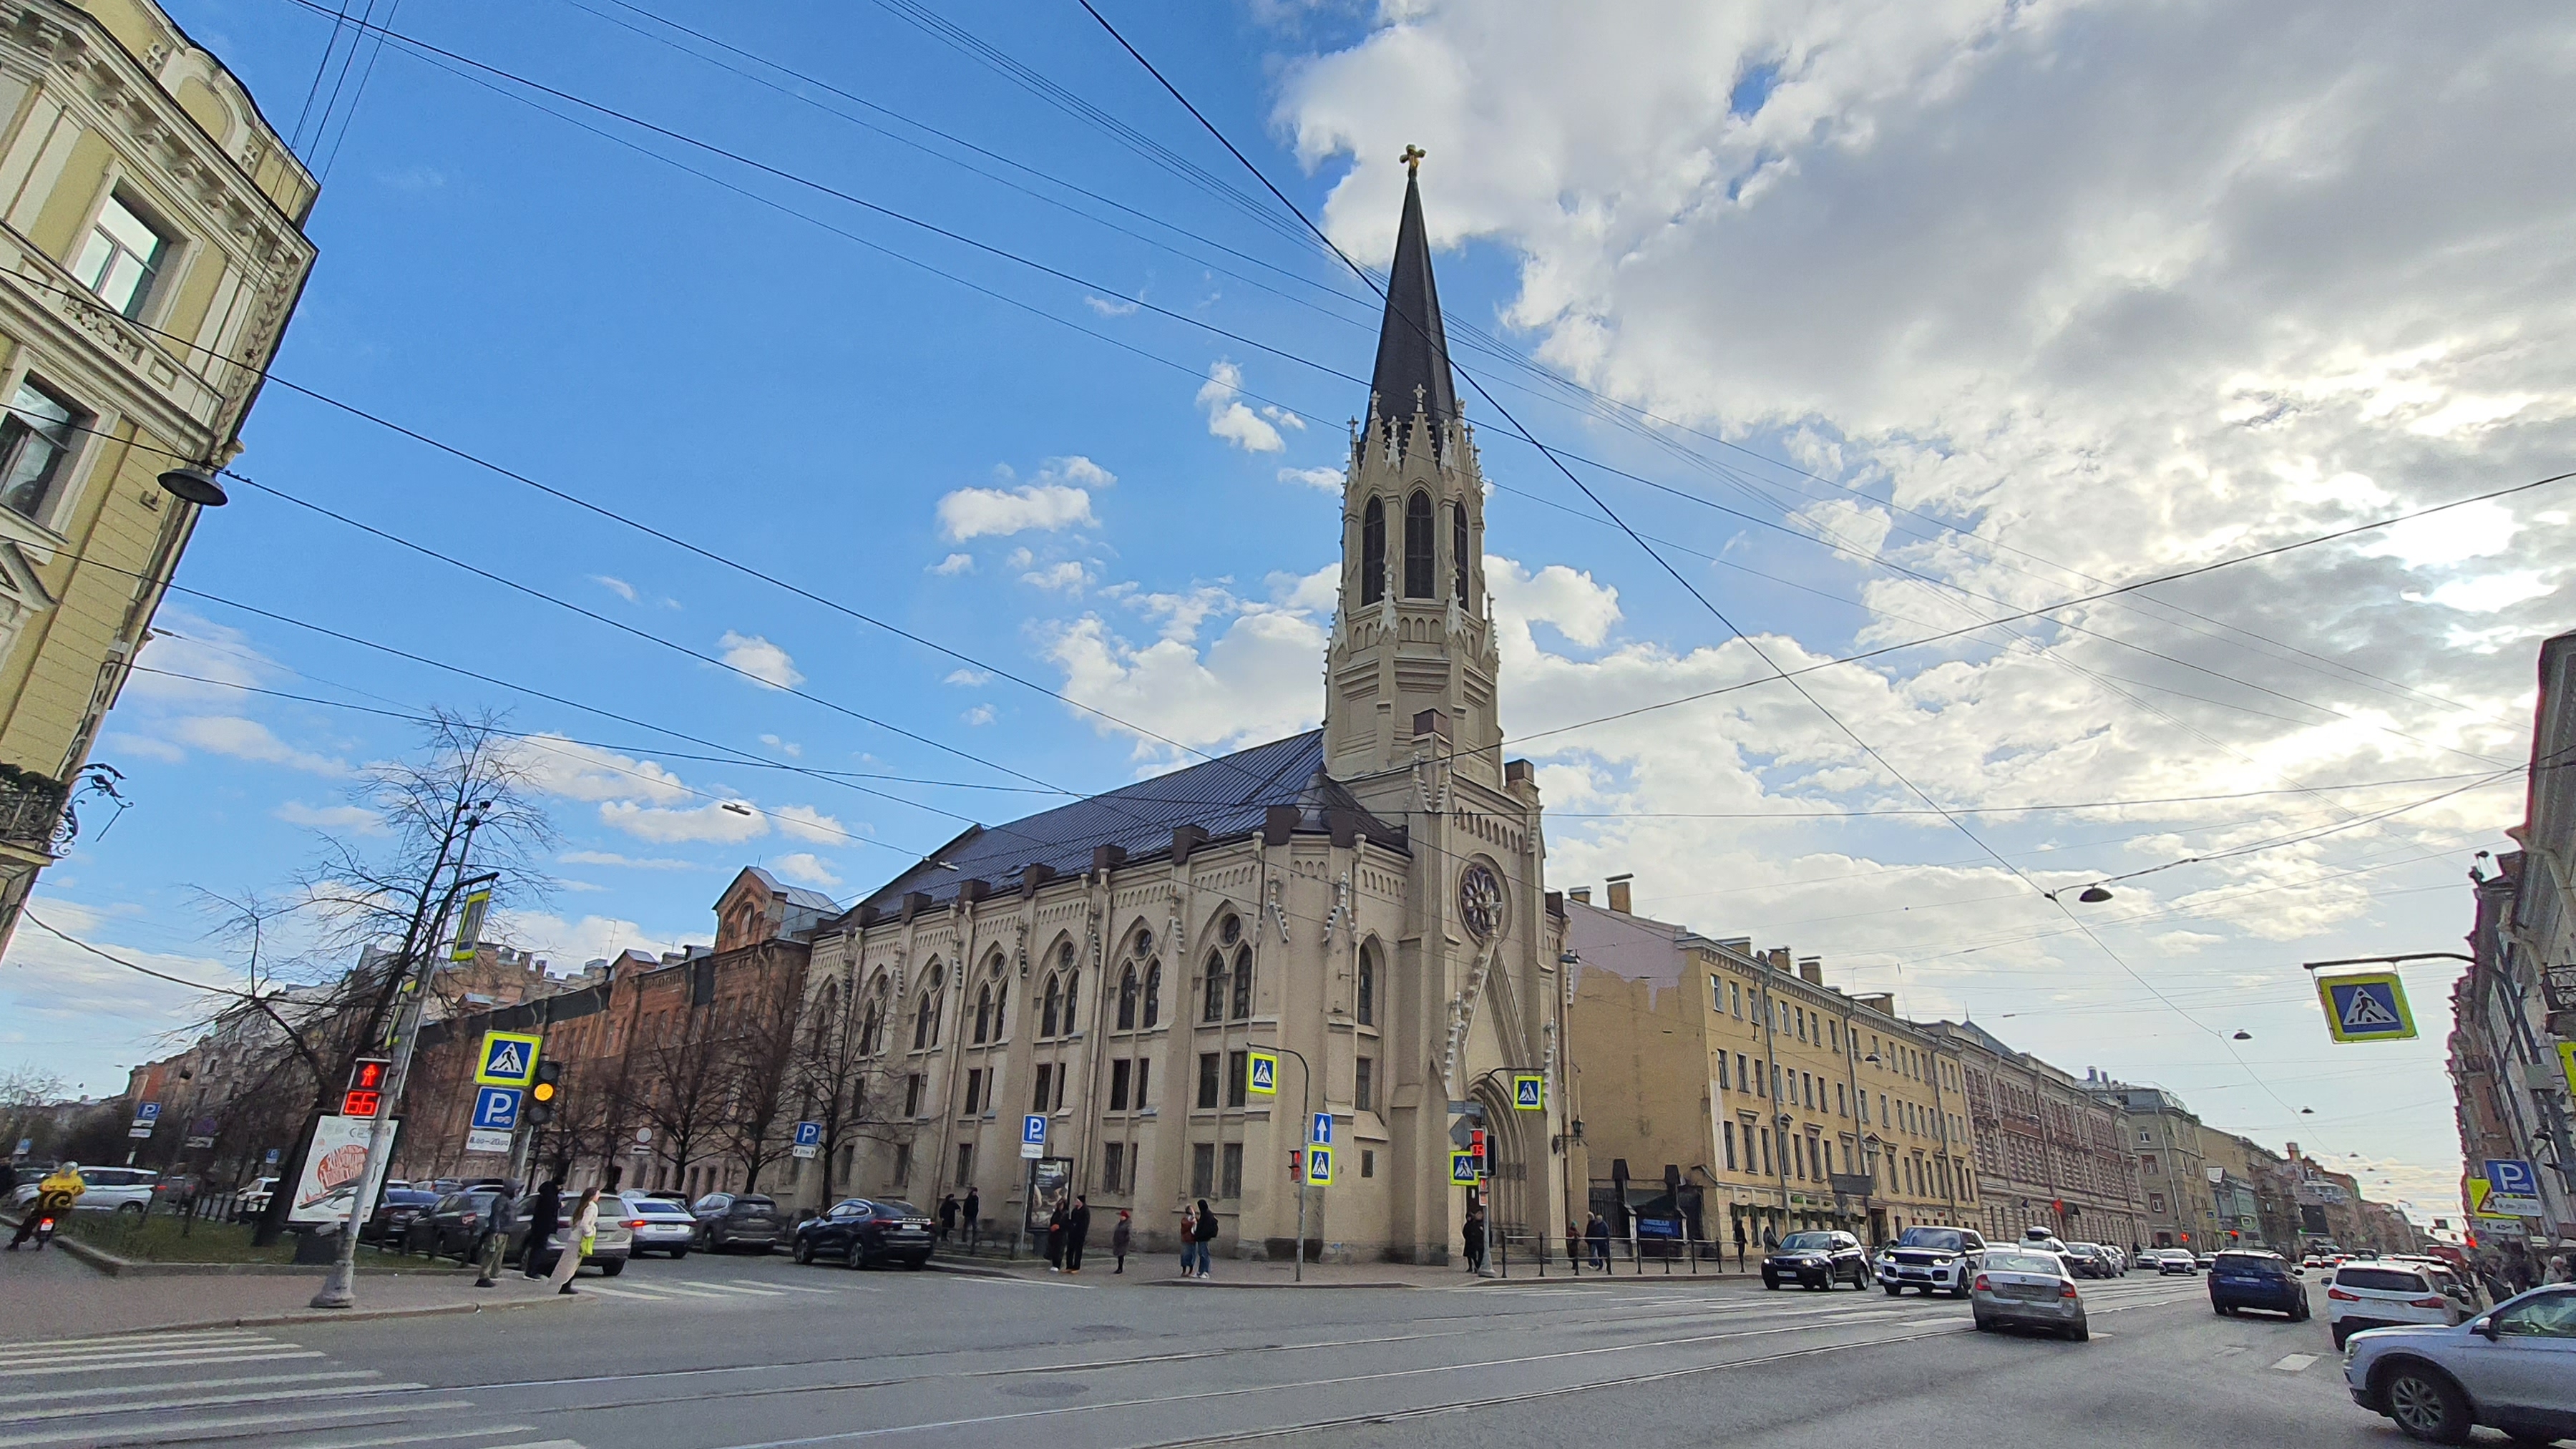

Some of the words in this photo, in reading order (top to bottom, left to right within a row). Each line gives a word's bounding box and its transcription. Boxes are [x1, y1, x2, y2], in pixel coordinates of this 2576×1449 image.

[344, 1092, 377, 1114] 66
[484, 1093, 512, 1123] P
[801, 1125, 816, 1141] P
[1029, 1118, 1042, 1139] P
[2497, 1163, 2524, 1190] P
